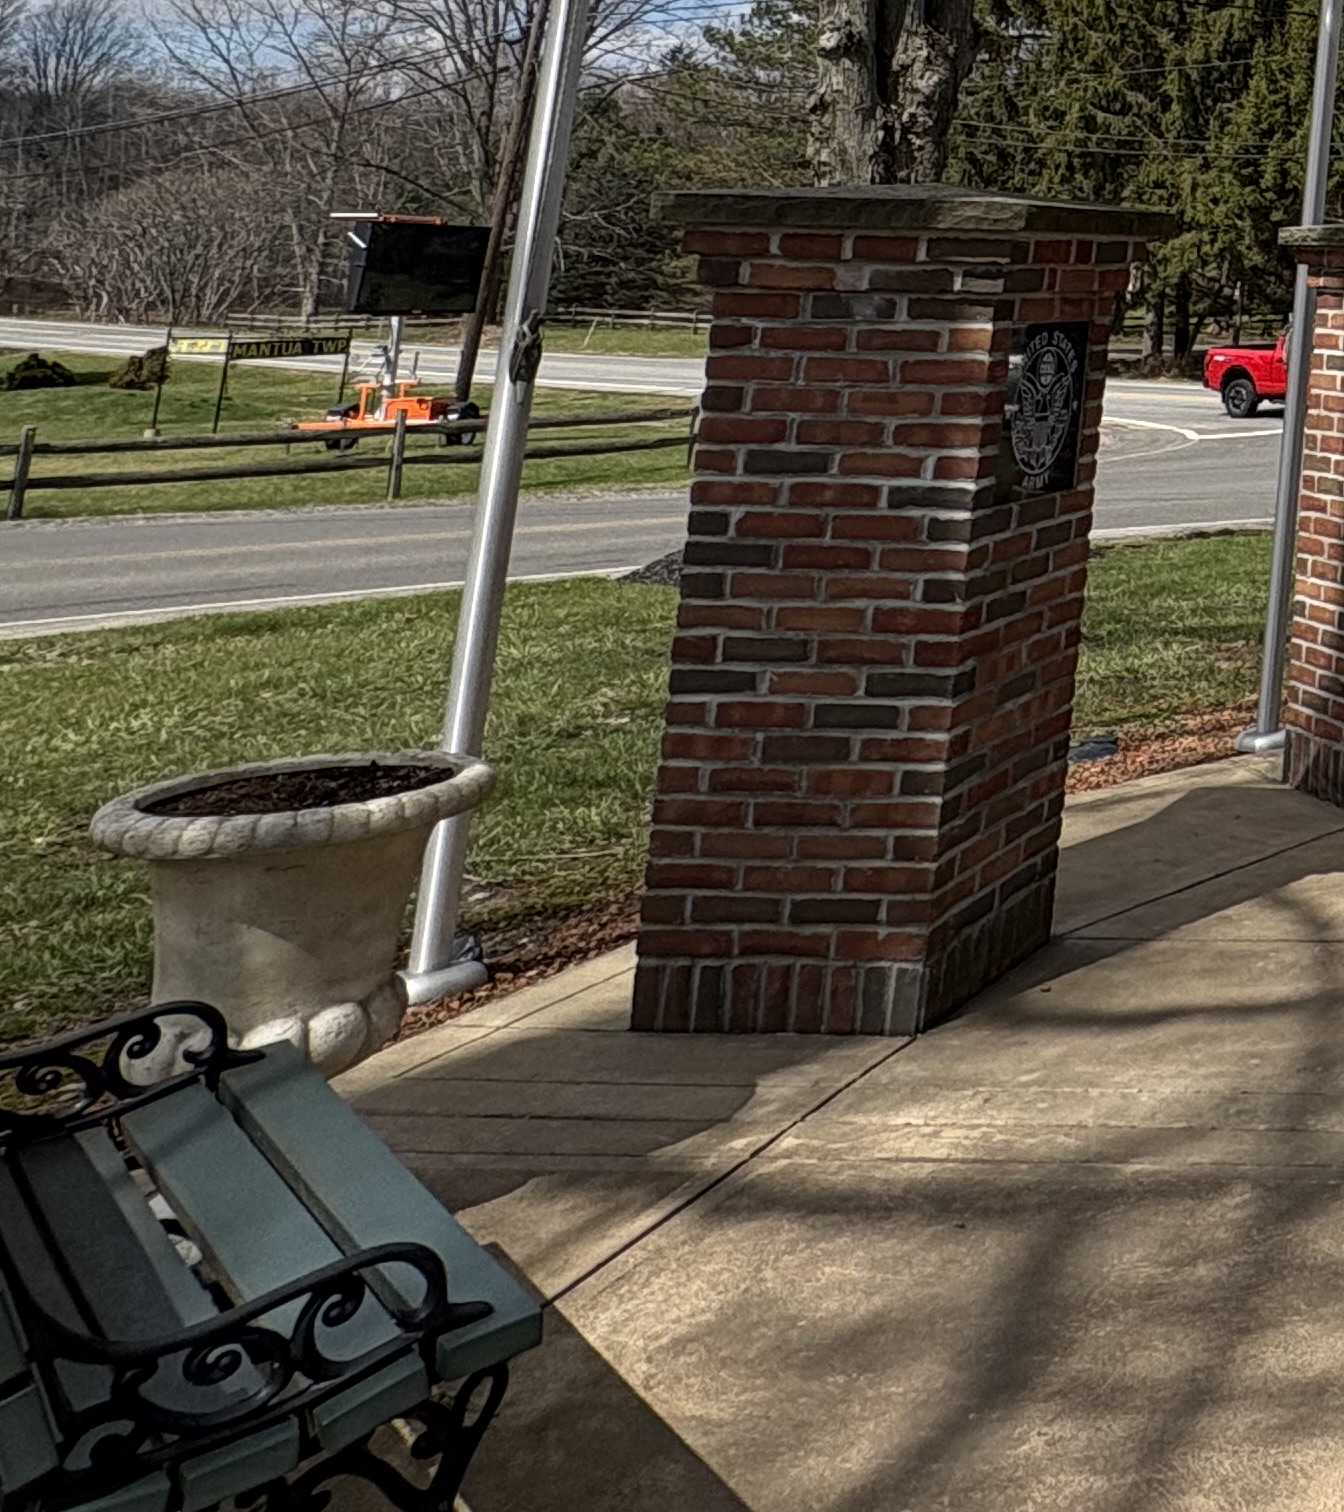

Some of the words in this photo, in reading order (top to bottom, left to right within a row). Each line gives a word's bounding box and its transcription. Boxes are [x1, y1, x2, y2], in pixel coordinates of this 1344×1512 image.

[233, 341, 303, 358] MANTUA
[1051, 331, 1078, 373] STATES
[1021, 469, 1050, 489] ARMY
